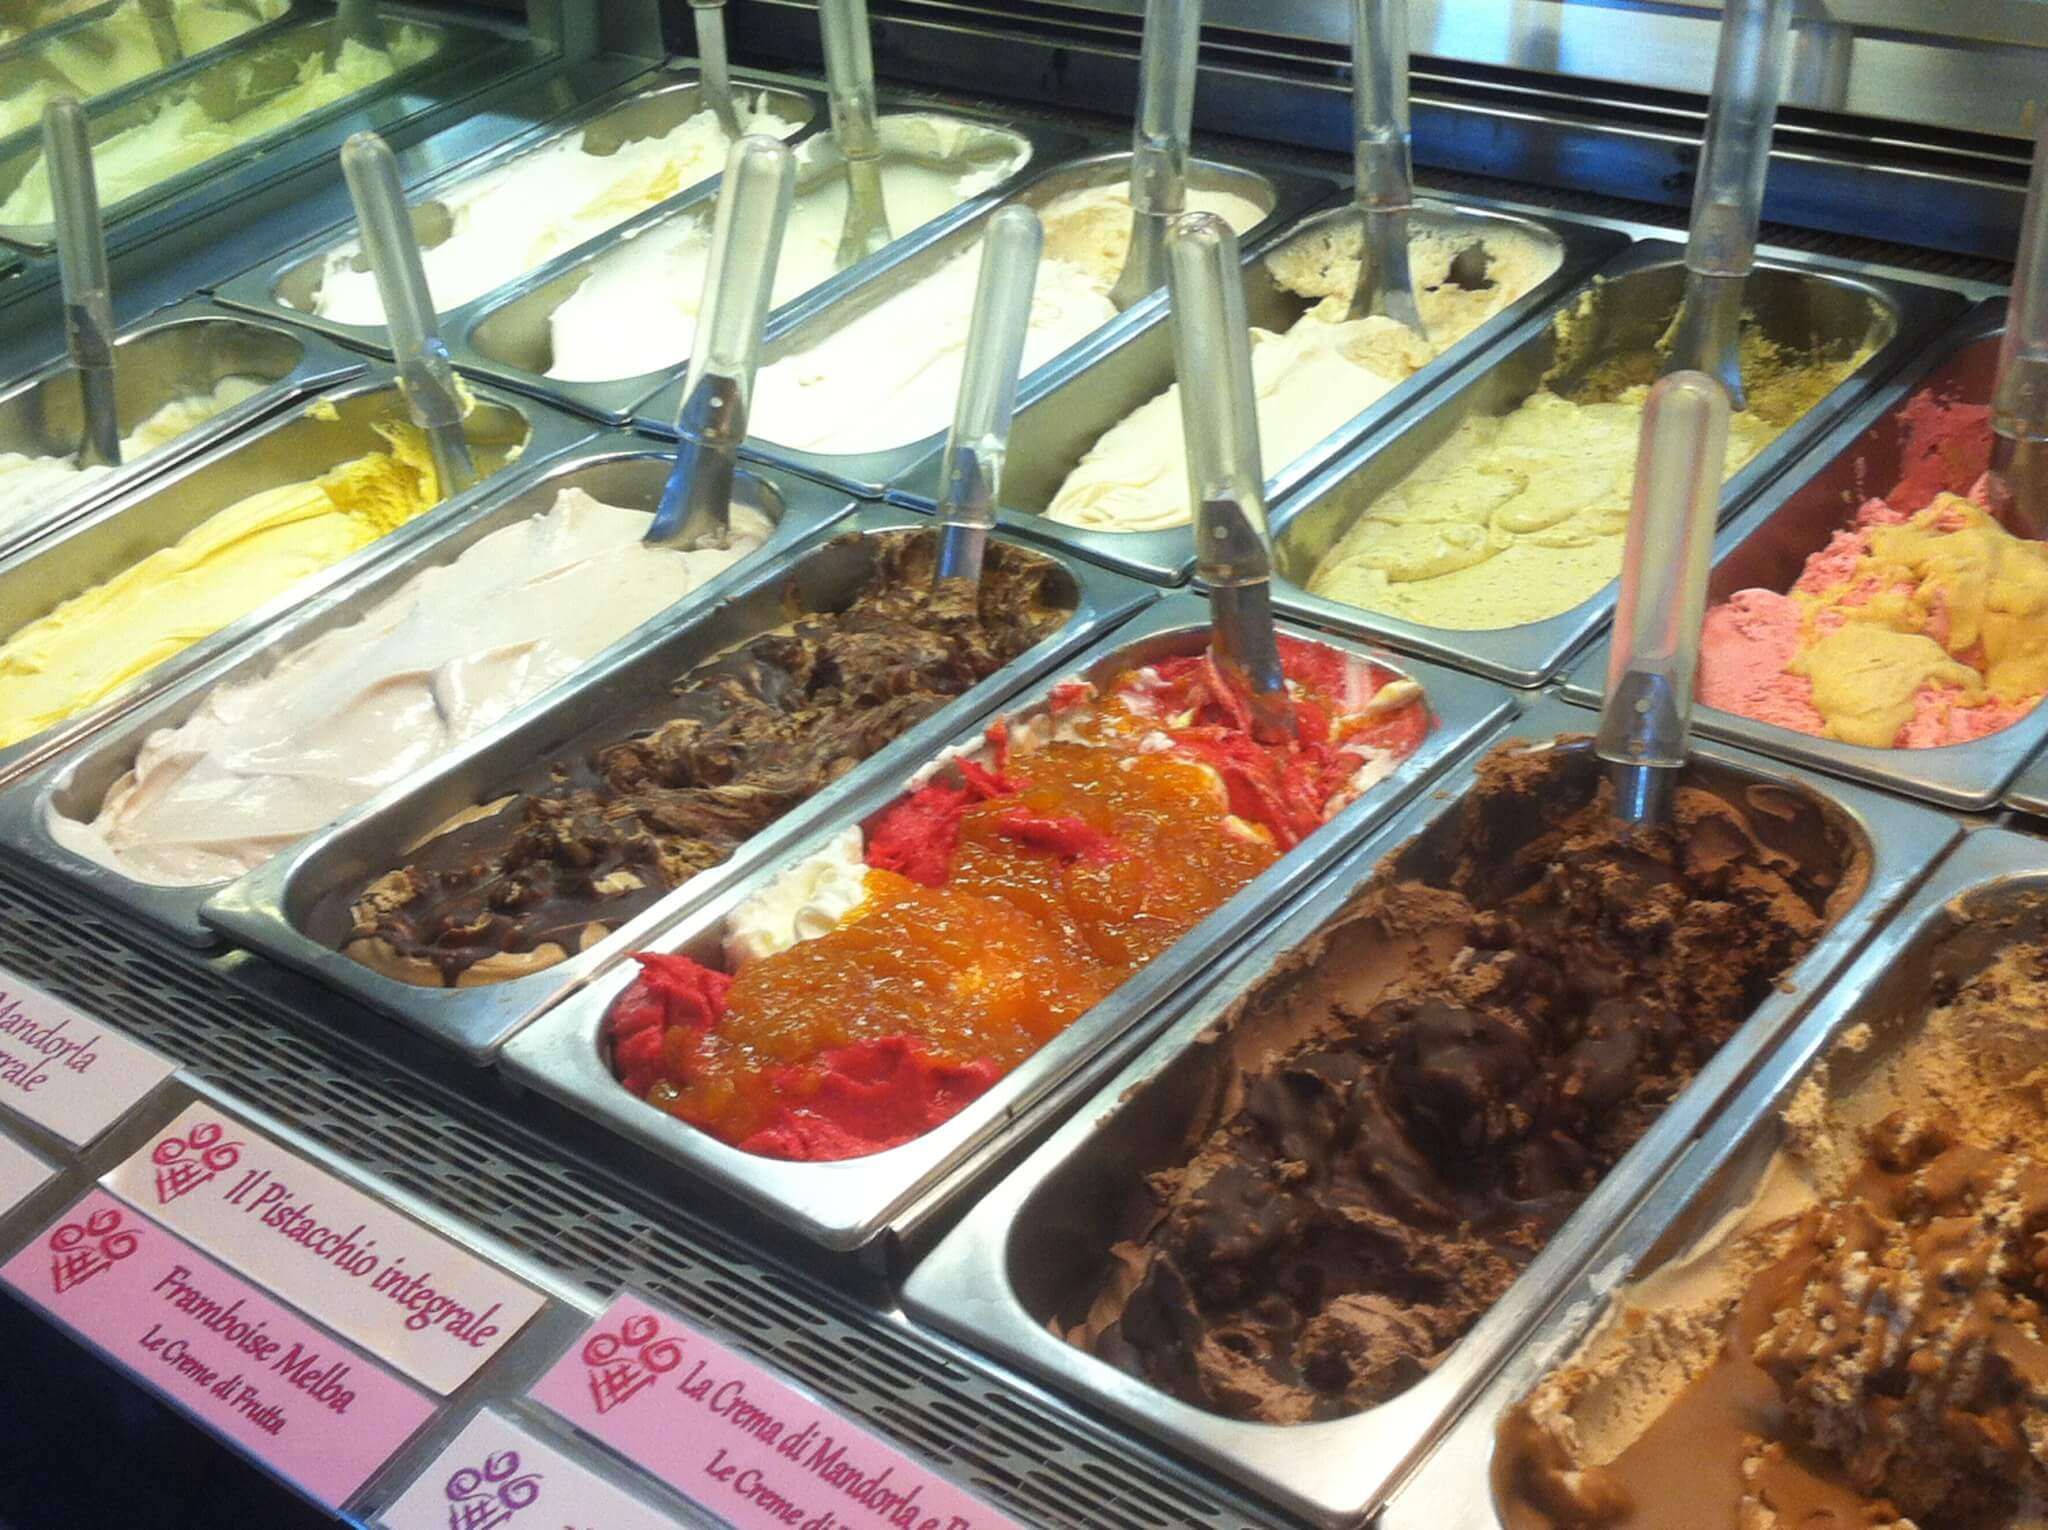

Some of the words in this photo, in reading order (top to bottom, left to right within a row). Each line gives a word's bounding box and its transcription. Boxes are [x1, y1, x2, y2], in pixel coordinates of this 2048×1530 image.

[223, 1169, 271, 1205] Il
[244, 1182, 379, 1277] Pistacchio
[152, 1265, 281, 1361] Framboise
[269, 1342, 356, 1414] Melba
[370, 1257, 503, 1347] integrale
[138, 1323, 167, 1352] Le
[161, 1340, 218, 1387] Creme
[209, 1374, 243, 1401] di
[228, 1385, 287, 1436] Frutta
[676, 1360, 714, 1402] La
[708, 1380, 785, 1446] Crema
[775, 1421, 821, 1462] di
[801, 1437, 924, 1530] Mandorla
[704, 1449, 737, 1483] Le
[733, 1469, 805, 1527] Creme
